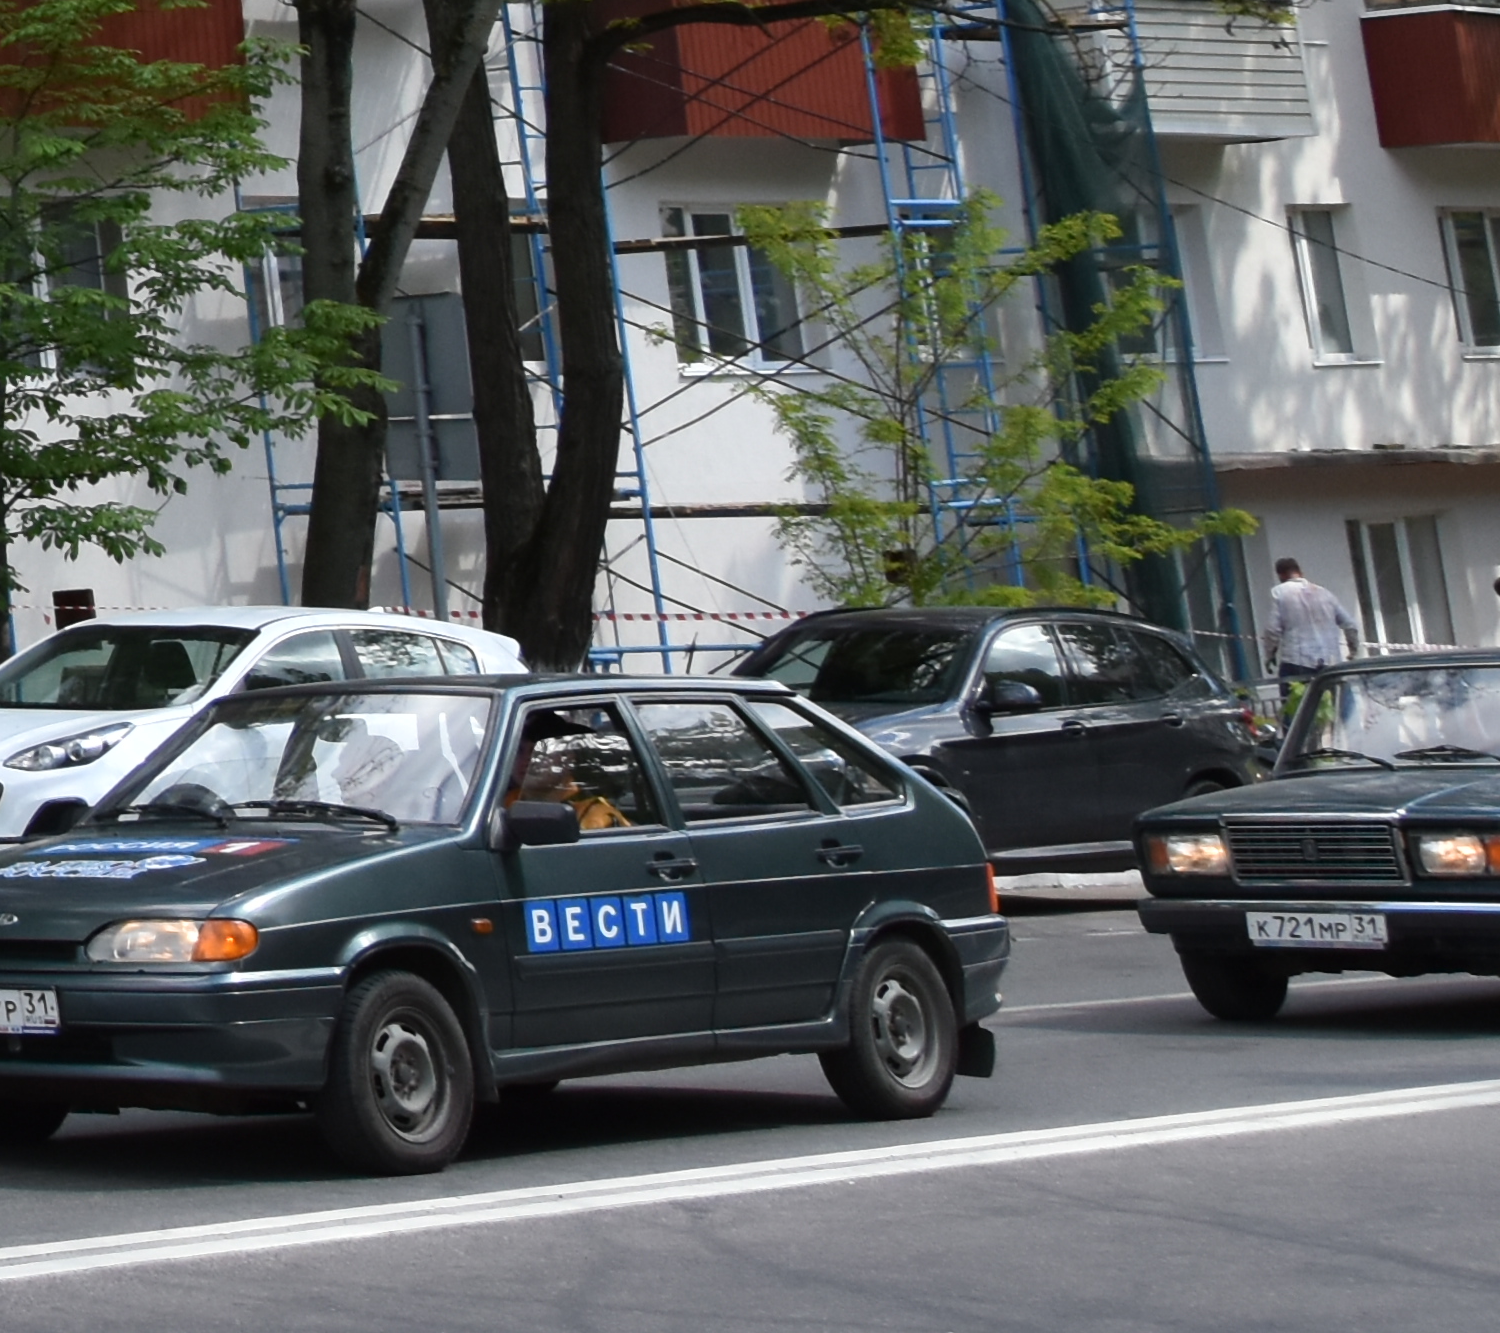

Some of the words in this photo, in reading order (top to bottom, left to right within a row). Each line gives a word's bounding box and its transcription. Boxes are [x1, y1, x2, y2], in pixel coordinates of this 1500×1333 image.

[218, 841, 262, 854] 1
[531, 900, 683, 944] ВЕСТИ
[1256, 916, 1348, 939] К721МР
[1354, 916, 1377, 934] 31
[23, 992, 49, 1016] 31
